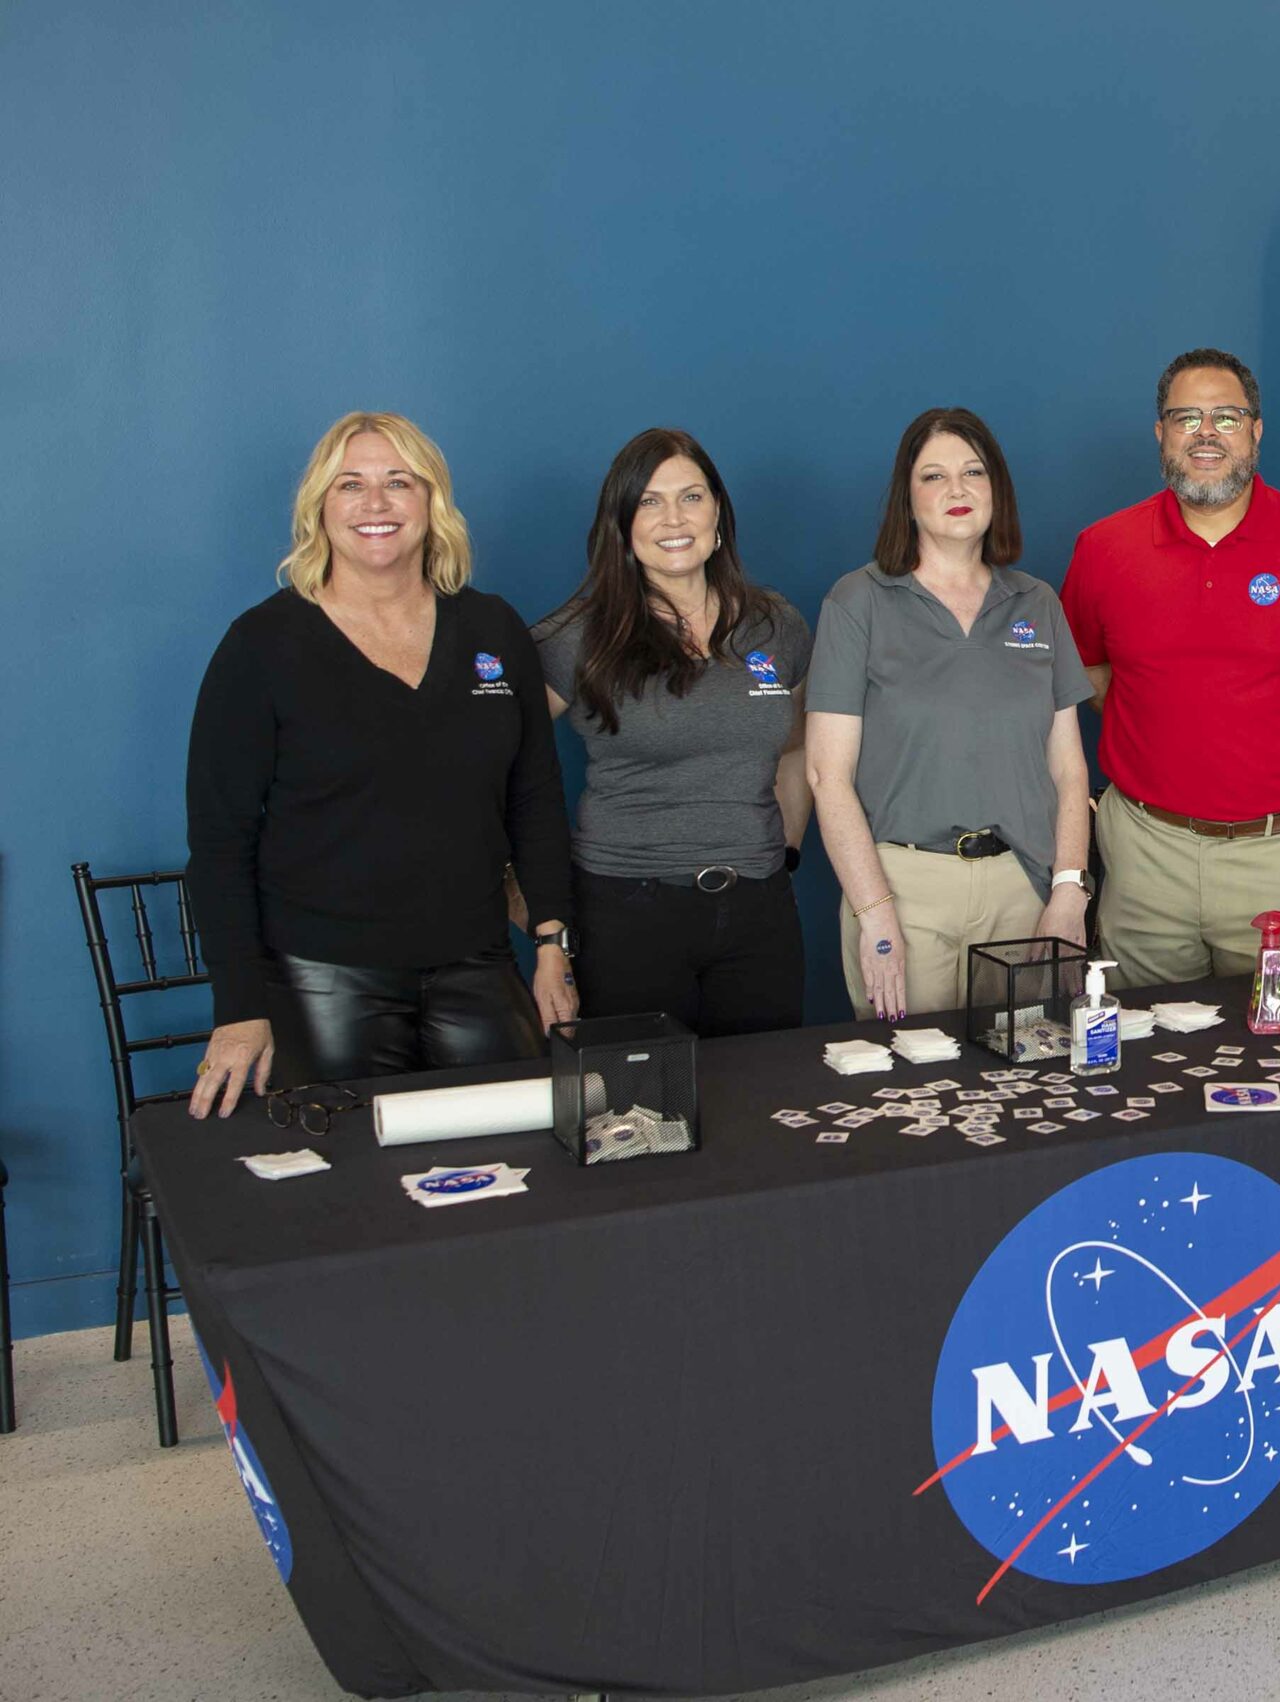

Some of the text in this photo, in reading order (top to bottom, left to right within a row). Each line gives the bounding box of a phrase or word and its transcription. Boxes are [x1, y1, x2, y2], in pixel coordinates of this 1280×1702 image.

[1250, 584, 1279, 594] NASA
[1012, 626, 1035, 635] NASA
[424, 1174, 492, 1190] NASA
